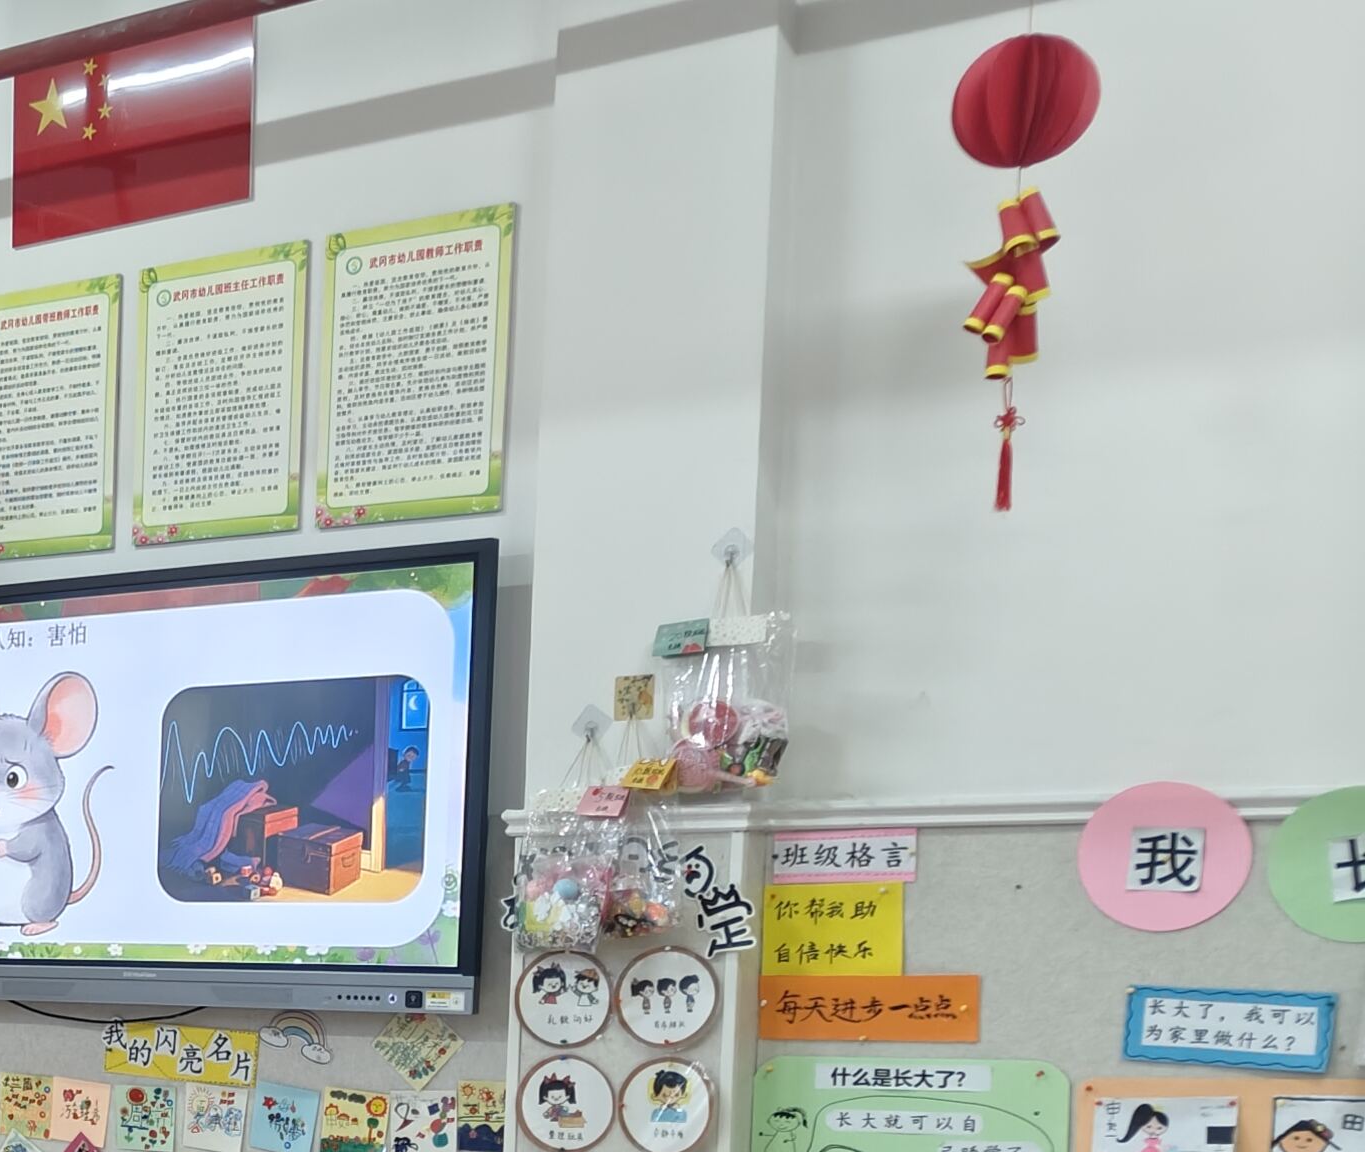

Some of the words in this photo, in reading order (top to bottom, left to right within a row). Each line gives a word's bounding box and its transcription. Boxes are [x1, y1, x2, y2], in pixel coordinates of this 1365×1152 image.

[369, 239, 483, 269] 武冈市幼儿园教师工作职责
[173, 273, 284, 302] 武冈市幼儿园班主任工作职责
[780, 841, 909, 869] 班级格言
[1135, 832, 1197, 887] 我
[774, 897, 878, 925] 你帮我助
[776, 990, 958, 1024] 每天进步一点点
[102, 1019, 252, 1081] 我的闪亮名片
[836, 1111, 977, 1133] 长大就可以自
